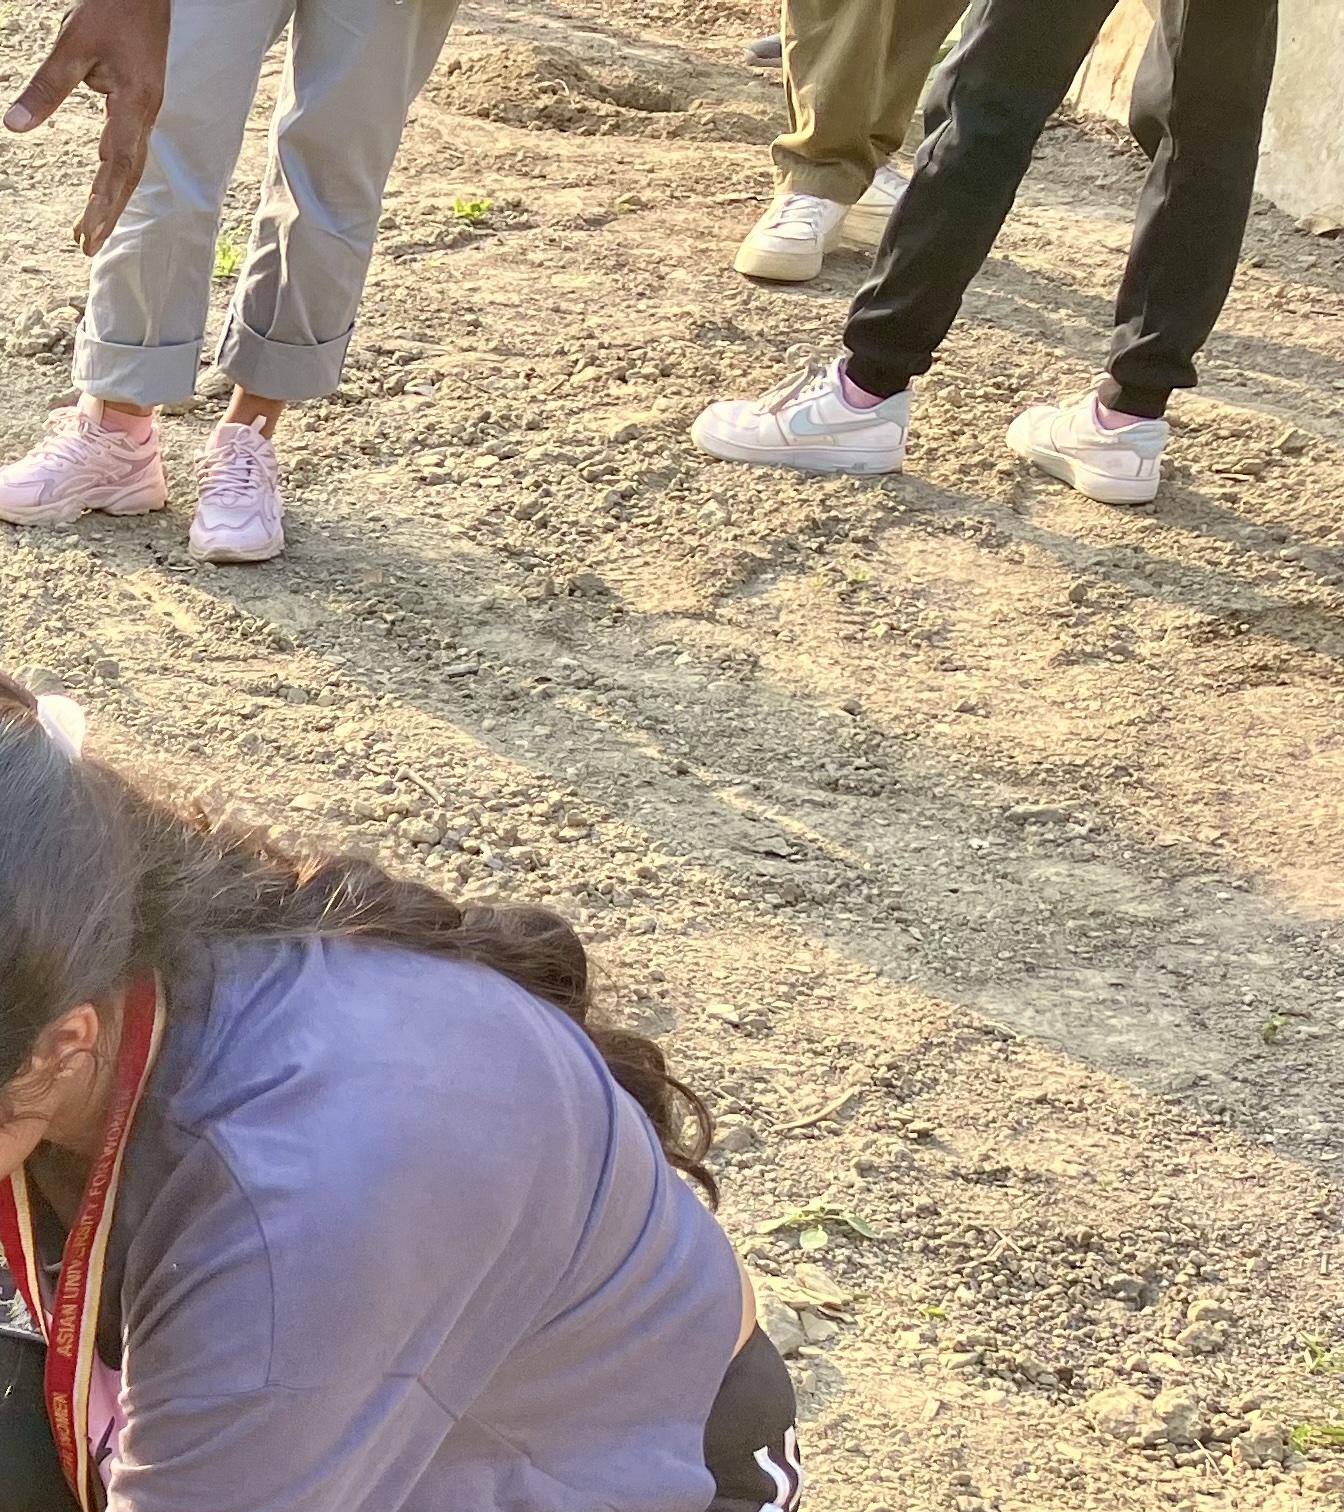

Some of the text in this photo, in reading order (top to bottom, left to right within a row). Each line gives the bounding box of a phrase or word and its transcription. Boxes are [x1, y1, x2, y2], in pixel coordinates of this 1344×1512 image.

[89, 1160, 113, 1197] FOR
[62, 1202, 99, 1299] UNIVERSITY
[56, 1303, 79, 1357] ASIAN
